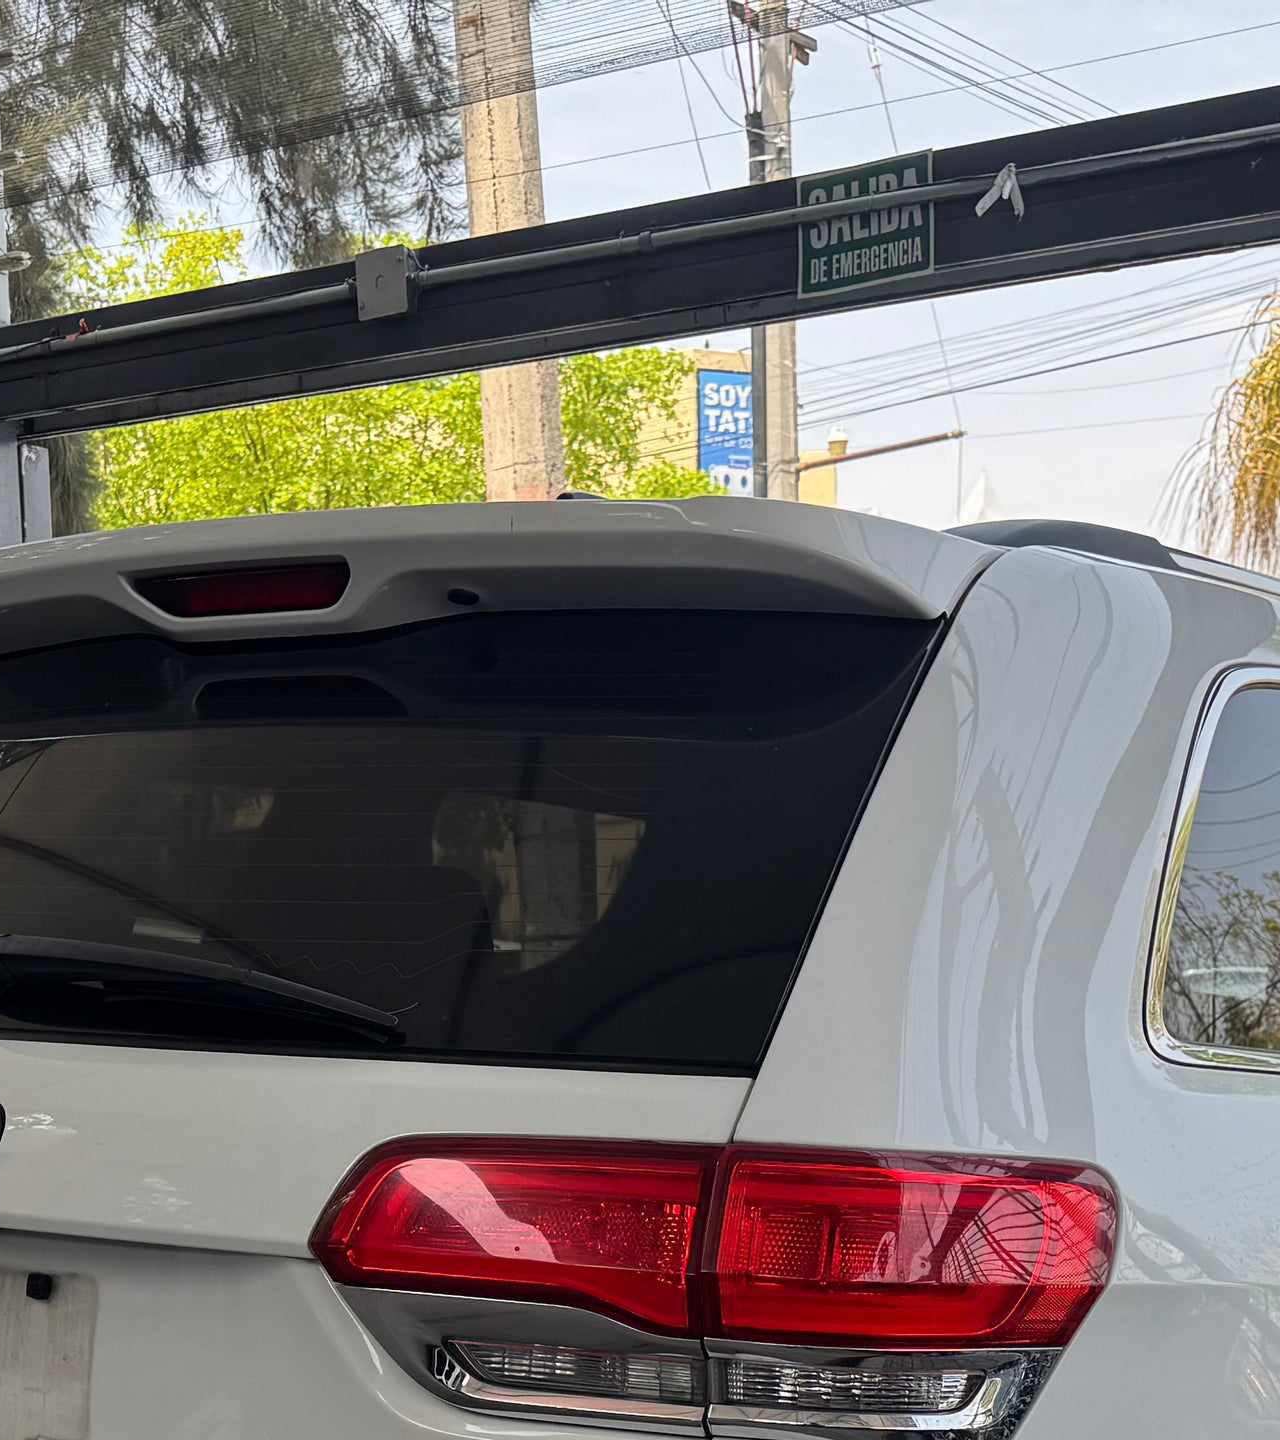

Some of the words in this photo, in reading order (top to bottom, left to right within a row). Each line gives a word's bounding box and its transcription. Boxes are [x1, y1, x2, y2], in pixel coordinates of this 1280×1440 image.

[808, 167, 923, 249] SALIDA
[810, 256, 828, 284] DE
[832, 236, 922, 280] EMERGENCIA
[704, 383, 752, 408] SOY
[704, 409, 753, 434] TAT
